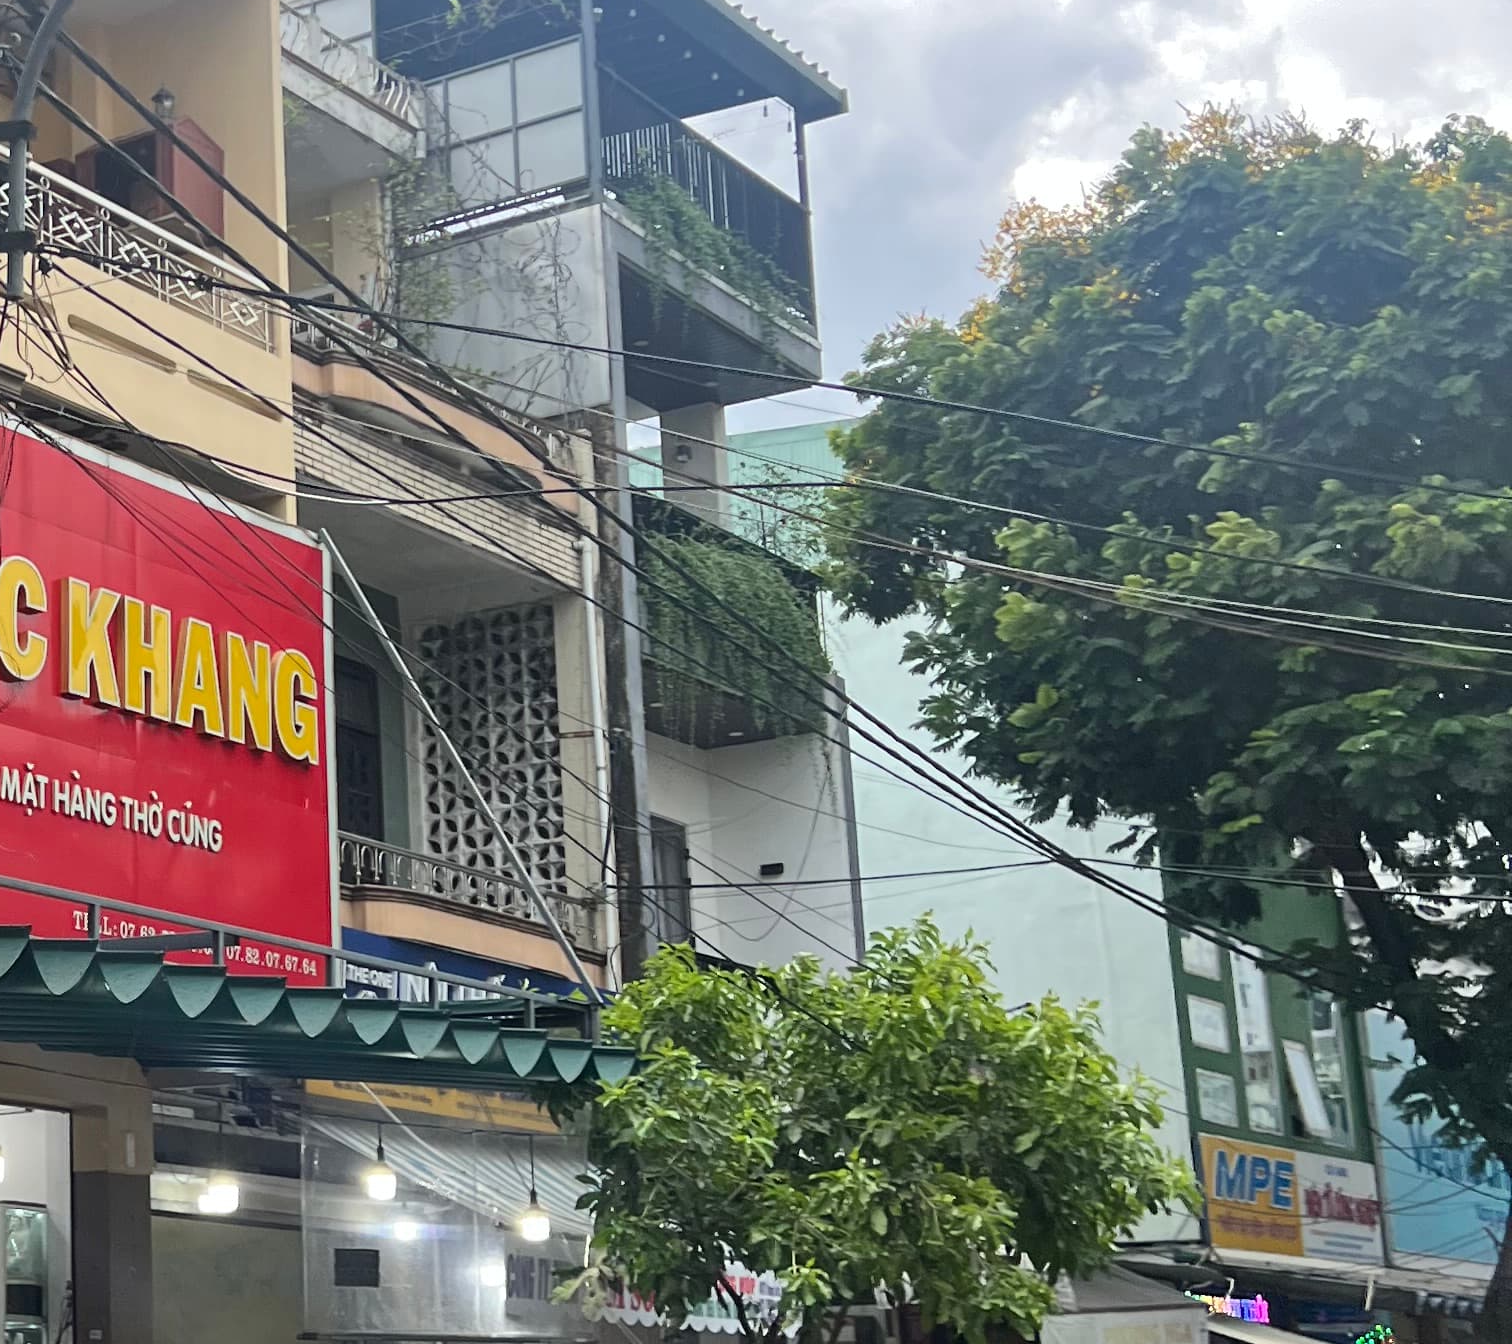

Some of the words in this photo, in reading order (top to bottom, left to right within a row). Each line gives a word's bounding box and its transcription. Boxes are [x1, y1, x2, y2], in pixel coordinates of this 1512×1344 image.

[61, 576, 319, 767] KHANG
[0, 762, 48, 816] MẶT
[53, 769, 117, 827] HÀNG
[121, 790, 163, 838] THỜ
[167, 800, 223, 853] CÚNG
[1214, 1149, 1295, 1210] MPE
